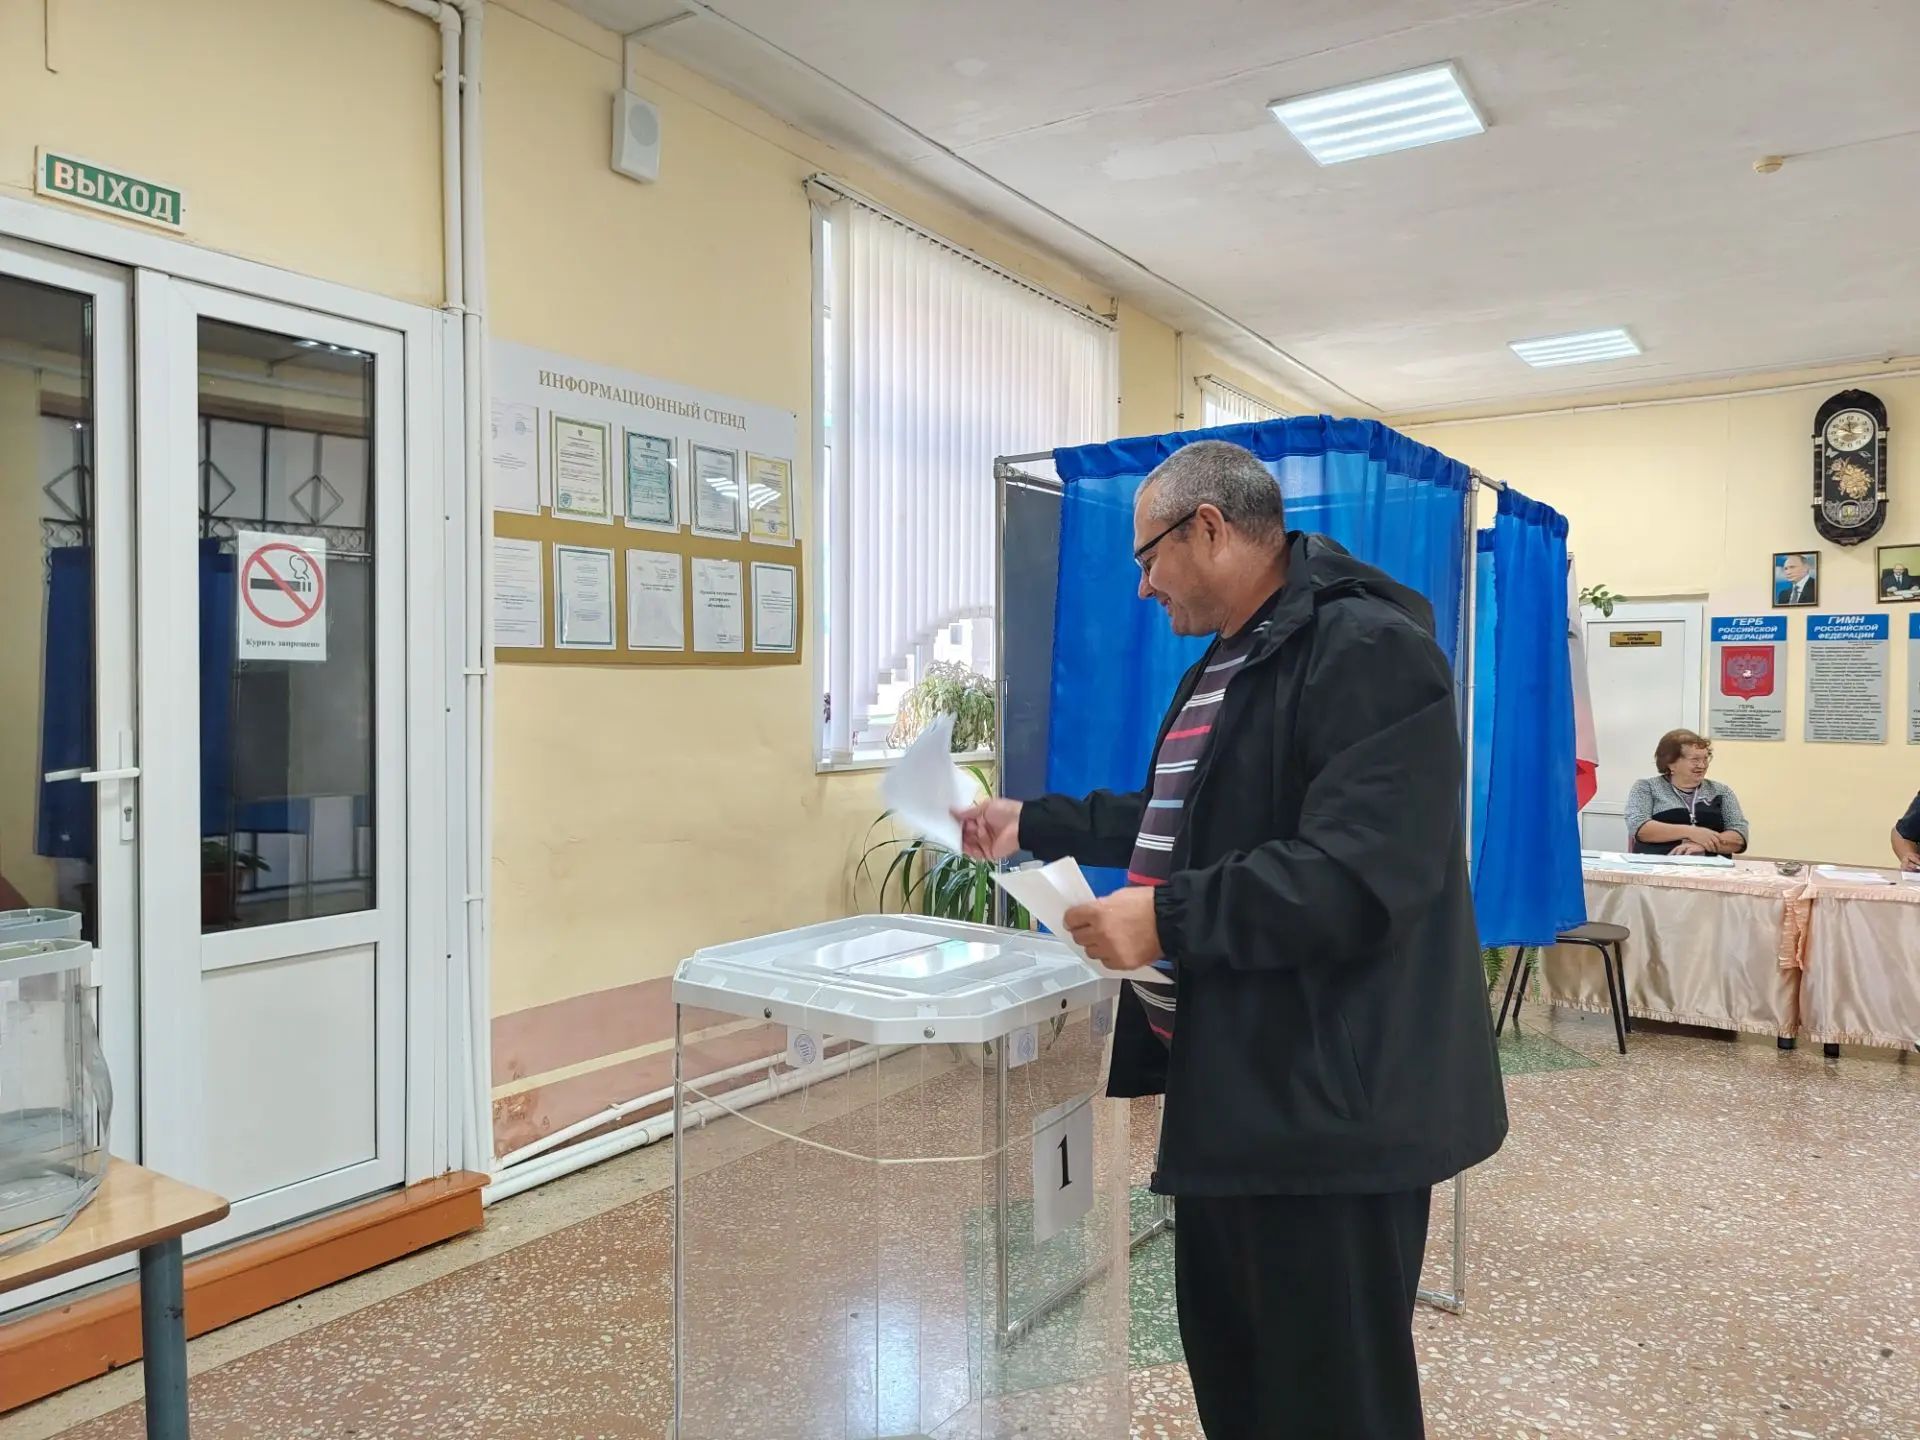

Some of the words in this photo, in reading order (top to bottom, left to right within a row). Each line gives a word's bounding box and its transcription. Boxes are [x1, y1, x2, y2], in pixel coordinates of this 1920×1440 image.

[54, 161, 173, 222] ВЫХОД
[538, 369, 701, 420] ИНФОРМАЦИОННЫЙ
[704, 408, 747, 432] СТЕНД
[1732, 617, 1764, 626] ГЕРБ
[1828, 615, 1865, 624] ГИМН
[1718, 625, 1778, 633] РОССИЙСКОЙ
[1814, 623, 1879, 633] РОССИЙСКОЙ
[1818, 632, 1875, 640] ФЕДЕРАЦИИ
[246, 638, 276, 648] Курить
[1057, 1134, 1072, 1190] 1
